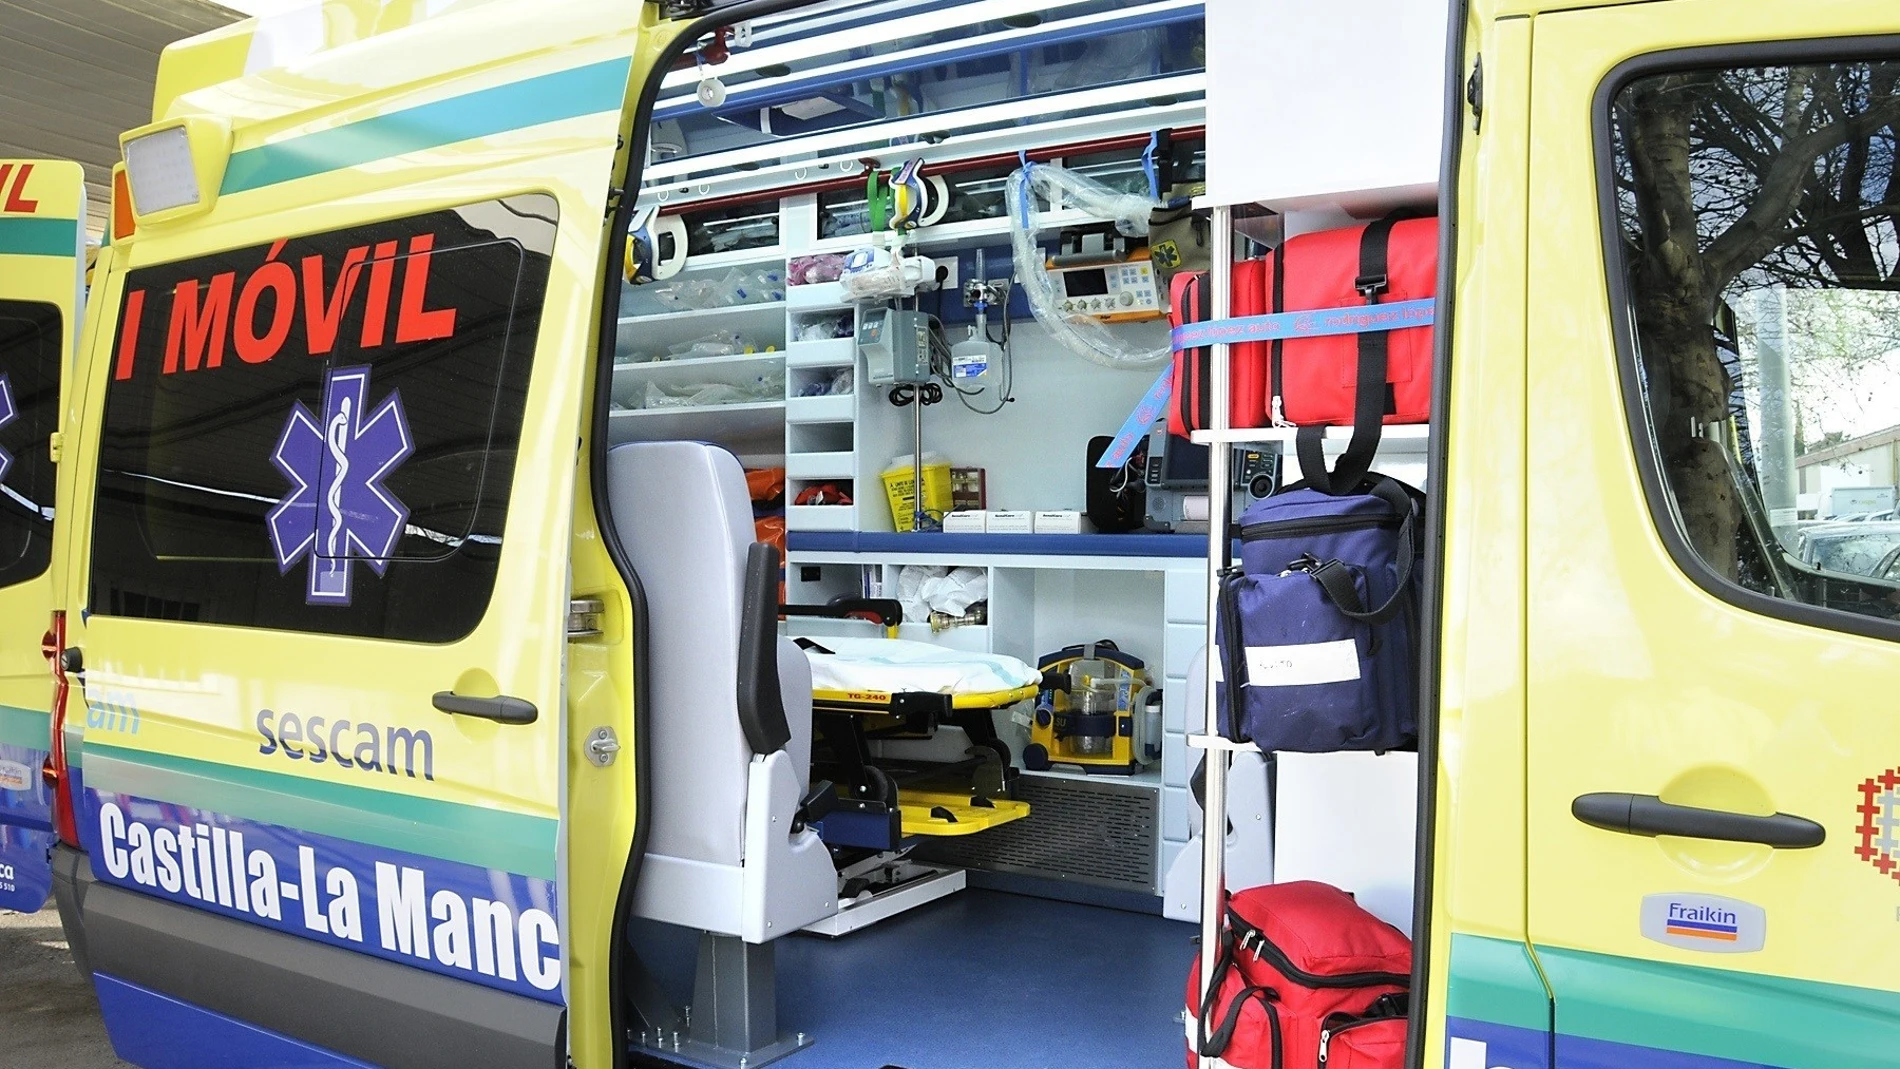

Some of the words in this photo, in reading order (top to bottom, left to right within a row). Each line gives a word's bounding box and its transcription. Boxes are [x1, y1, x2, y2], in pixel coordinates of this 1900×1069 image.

[162, 233, 457, 374] MÓVIL
[86, 687, 141, 735] am
[847, 692, 887, 701] TG-240
[257, 708, 435, 782] sescam
[100, 802, 363, 942] Castilla-La
[375, 861, 561, 991] Manc
[1669, 902, 1736, 924] Fraikin
